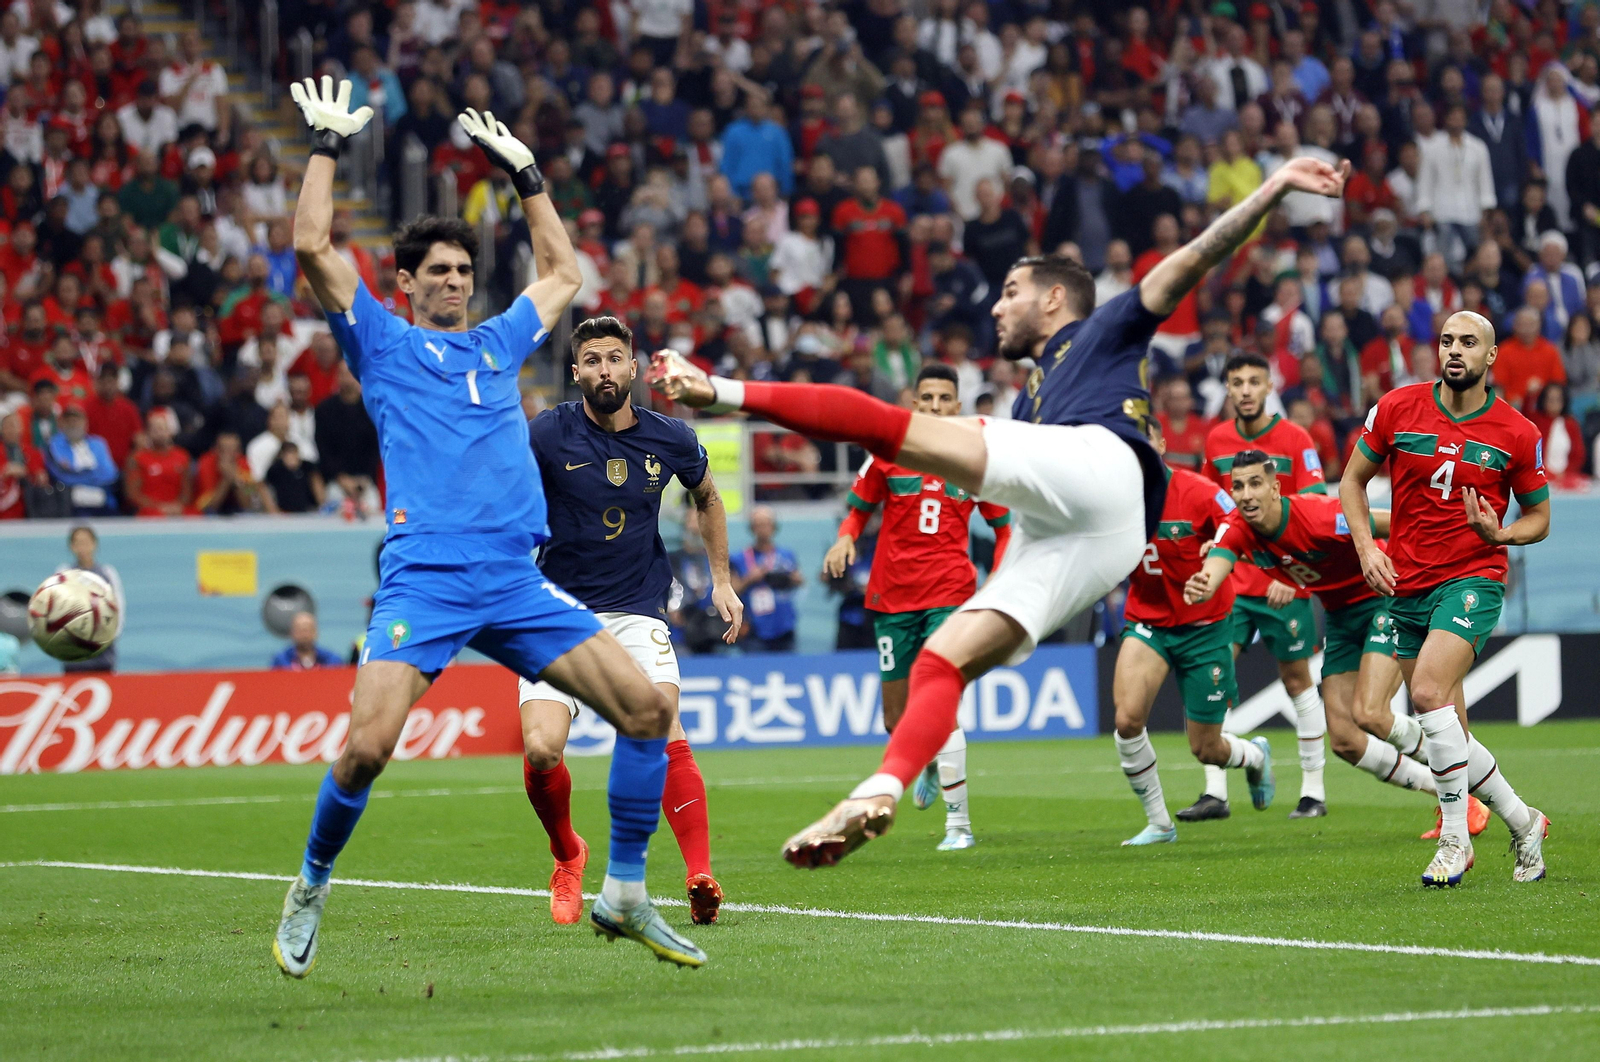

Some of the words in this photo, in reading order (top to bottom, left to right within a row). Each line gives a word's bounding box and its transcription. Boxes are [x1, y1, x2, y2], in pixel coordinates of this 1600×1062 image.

[466, 370, 481, 406] 1
[1430, 460, 1456, 500] 4
[602, 506, 626, 541] 9
[918, 498, 942, 535] 8
[1142, 542, 1163, 576] 2
[650, 628, 671, 655] 9
[877, 635, 896, 672] 8
[805, 667, 1084, 736] WDA
[0, 677, 486, 775] Budweier
